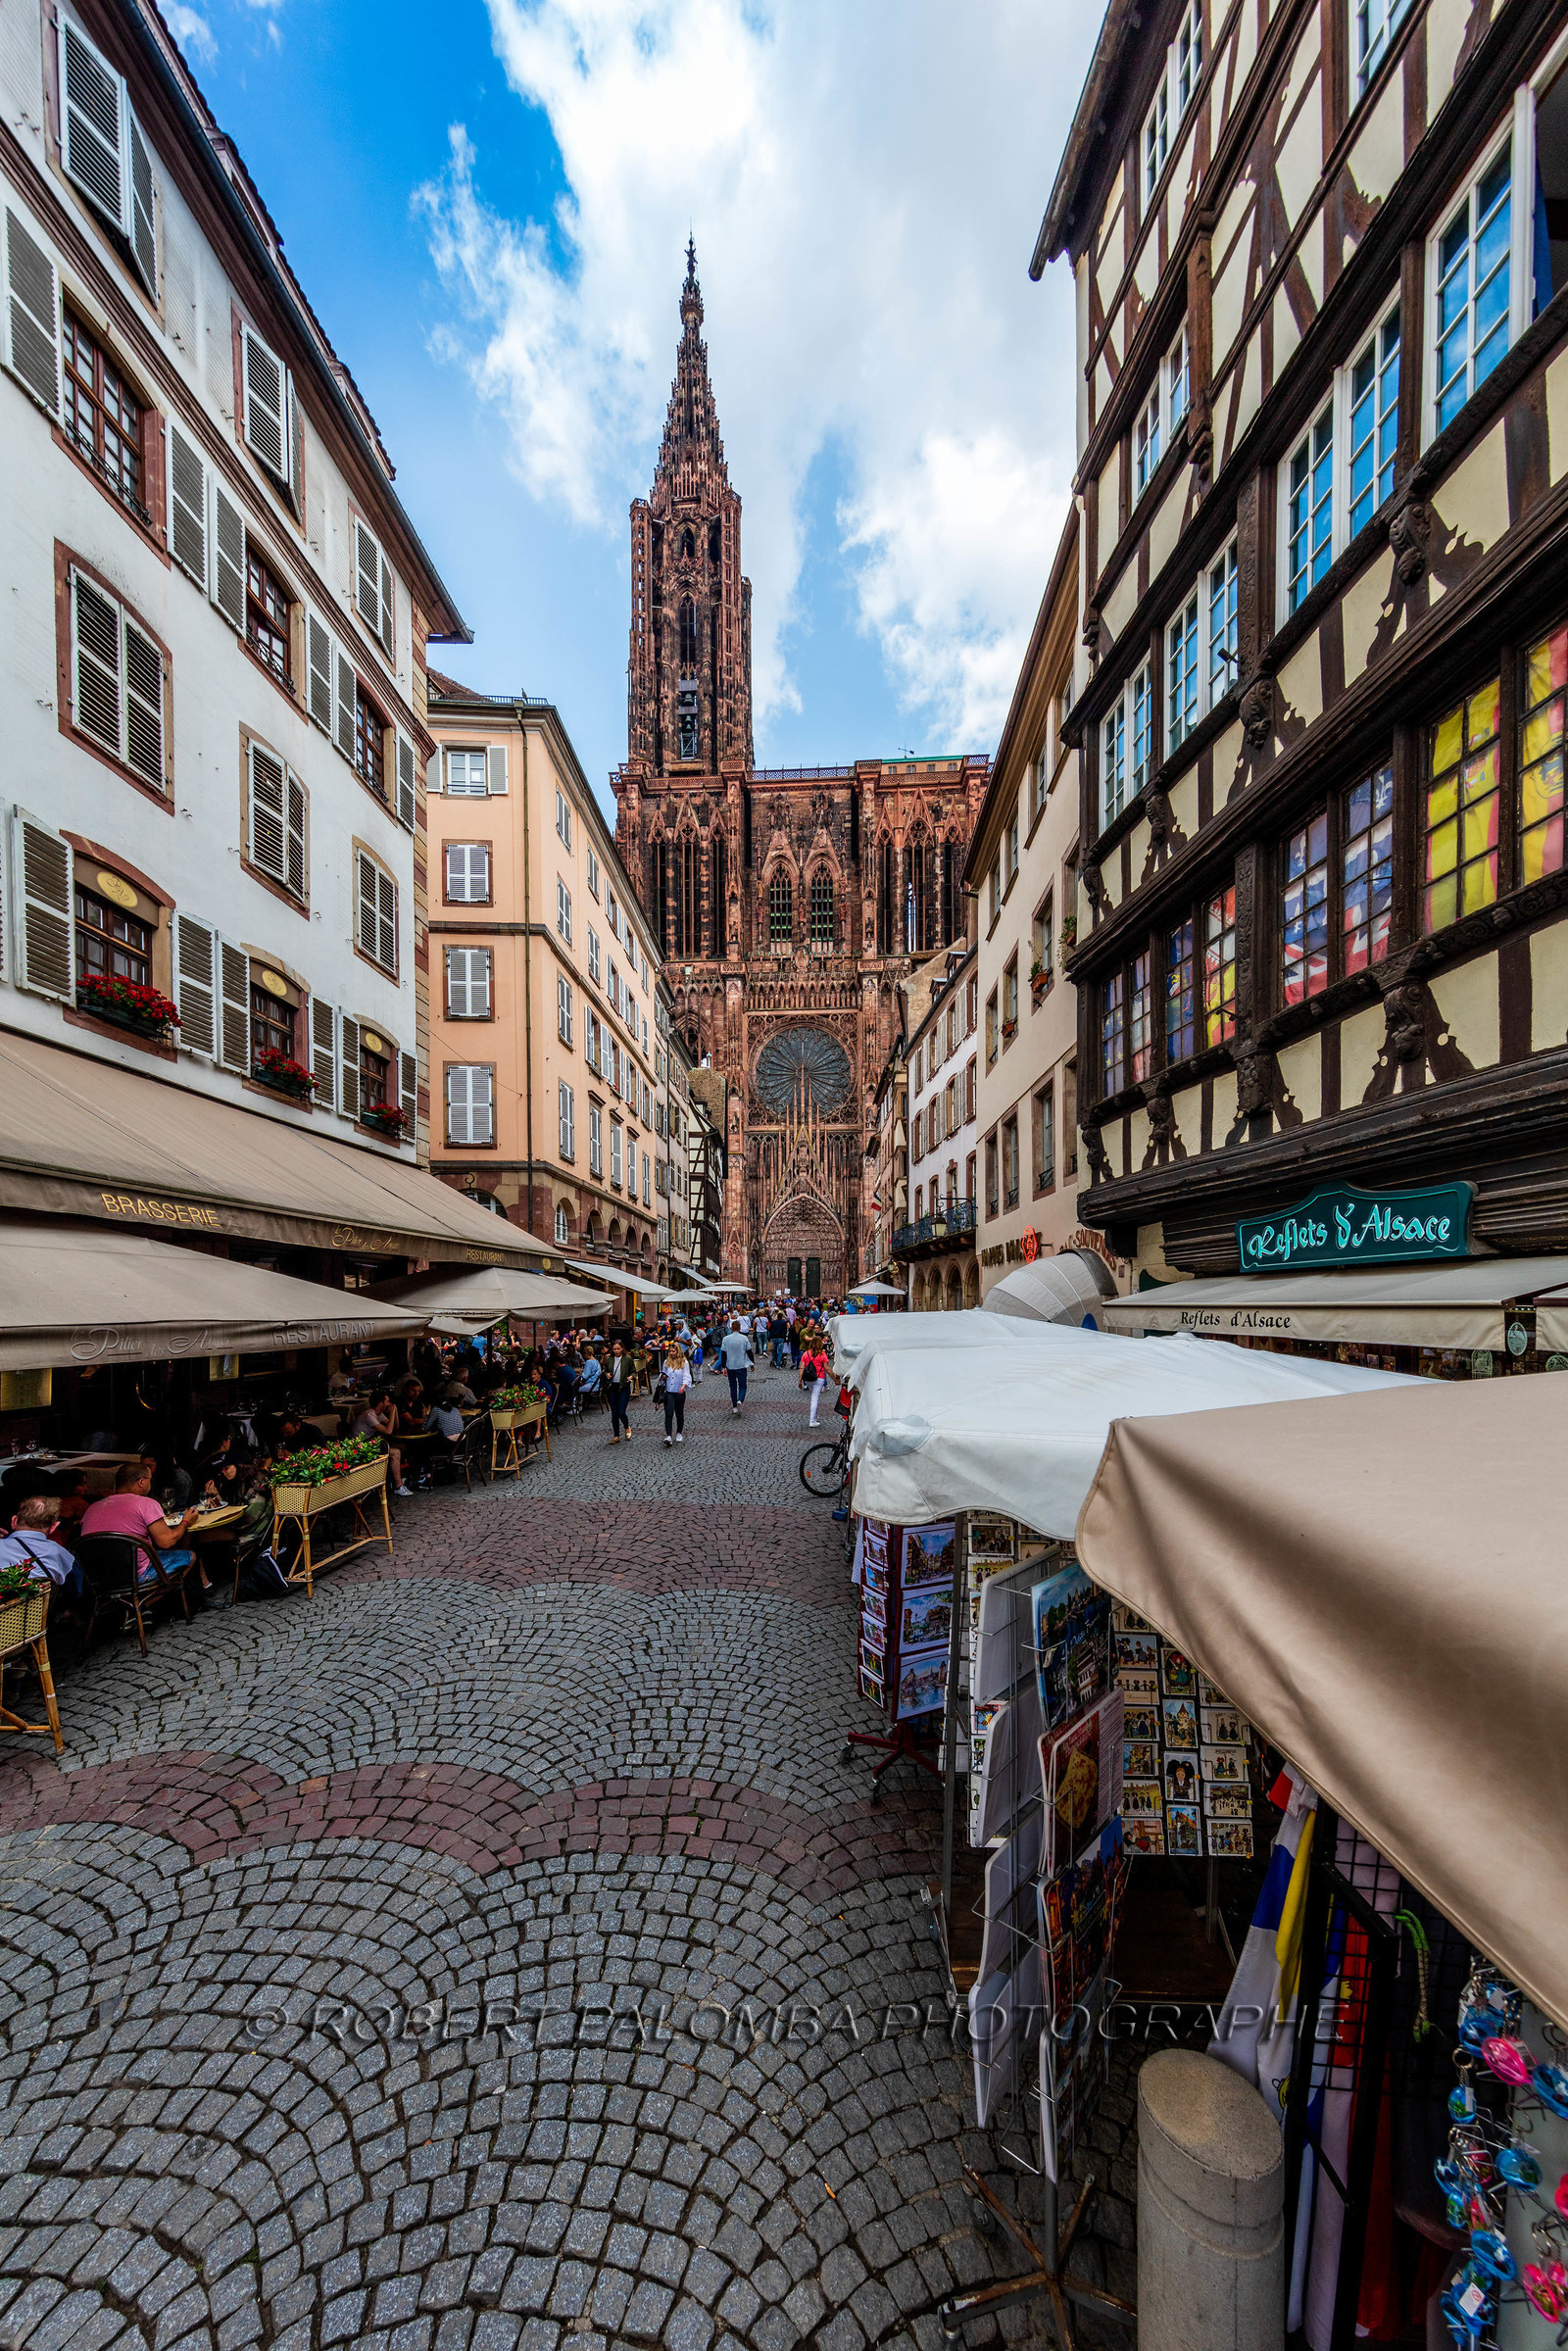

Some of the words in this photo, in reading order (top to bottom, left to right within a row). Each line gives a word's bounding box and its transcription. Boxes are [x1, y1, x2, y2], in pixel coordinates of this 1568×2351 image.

[101, 1193, 221, 1227] BRASSERIE
[1247, 1218, 1328, 1261] Reflets
[1333, 1202, 1450, 1249] d'Alsace
[466, 1249, 505, 1262] RESTAURANT
[272, 1321, 375, 1346] RESTAURANT
[1180, 1310, 1221, 1330] Reflets
[1230, 1310, 1291, 1328] d'Alsace
[71, 1327, 144, 1360] Pilier
